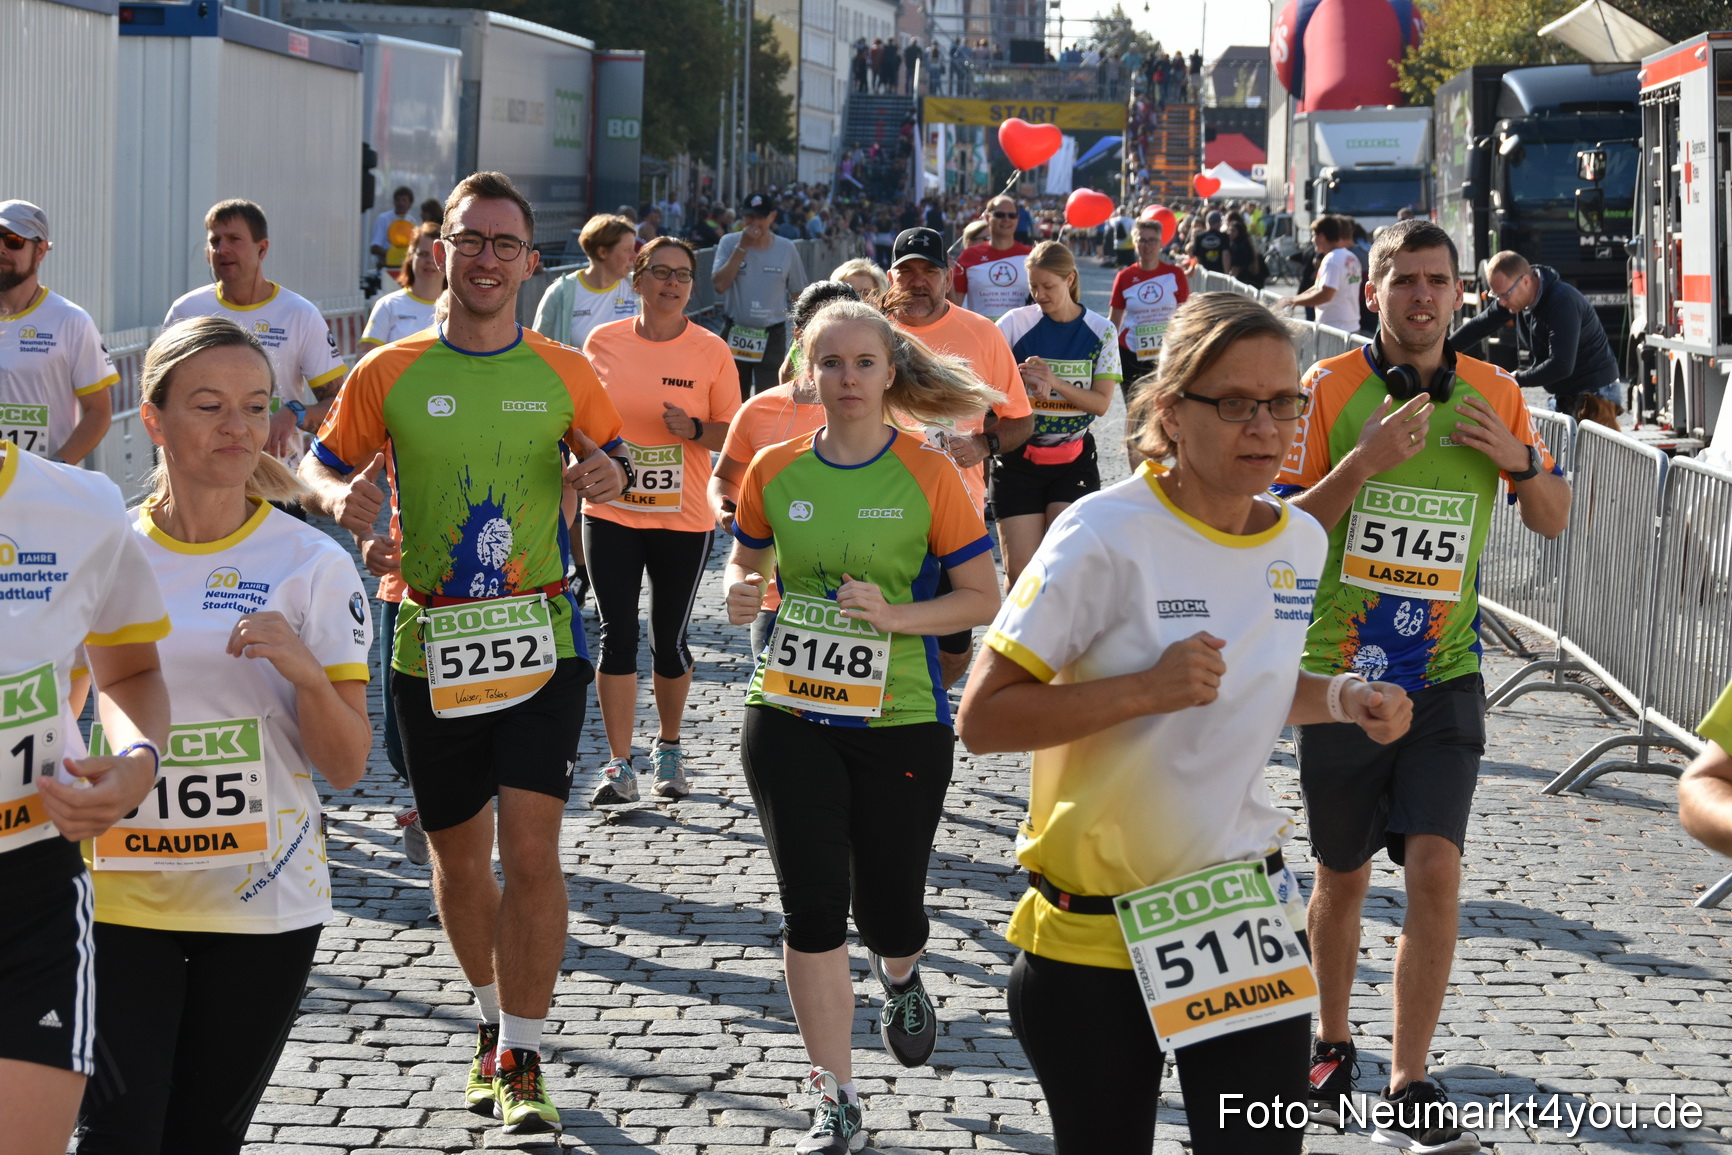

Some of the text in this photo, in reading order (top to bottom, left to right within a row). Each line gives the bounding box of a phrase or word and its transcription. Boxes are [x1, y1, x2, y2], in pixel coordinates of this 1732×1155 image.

[989, 103, 1059, 123] START
[607, 118, 640, 140] BO
[20, 328, 37, 339] 20
[20, 339, 57, 347] Neumarkter
[732, 336, 762, 350] 5041
[19, 346, 50, 354] Stadtlauf
[1048, 362, 1087, 375] OCK
[661, 377, 694, 388] THULE
[502, 400, 547, 412] BOCK
[629, 446, 677, 464] OCK
[624, 494, 656, 505] ELKE
[1363, 487, 1466, 521] BOCK
[858, 508, 903, 519] BOCK
[1360, 521, 1457, 563] 5145
[0, 543, 53, 566] 0 JAHRE
[0, 570, 68, 582] umarkter
[209, 572, 267, 592] 20 JAHRE
[1269, 568, 1295, 590] 20
[1368, 565, 1439, 586] LASZLO
[0, 586, 52, 602] adtlauf
[1157, 599, 1209, 614] BOCK
[432, 600, 540, 637] BOCK
[440, 635, 541, 679] 5252
[777, 633, 873, 678] 5148
[788, 680, 849, 702] LAURA
[123, 772, 246, 820] 165
[125, 832, 239, 853] CLAUDIA
[240, 878, 270, 902] 14./15.
[267, 832, 304, 880] September
[1130, 870, 1266, 935] BOCK
[1155, 917, 1284, 989] 5116
[1186, 980, 1295, 1021] CLAUDIA
